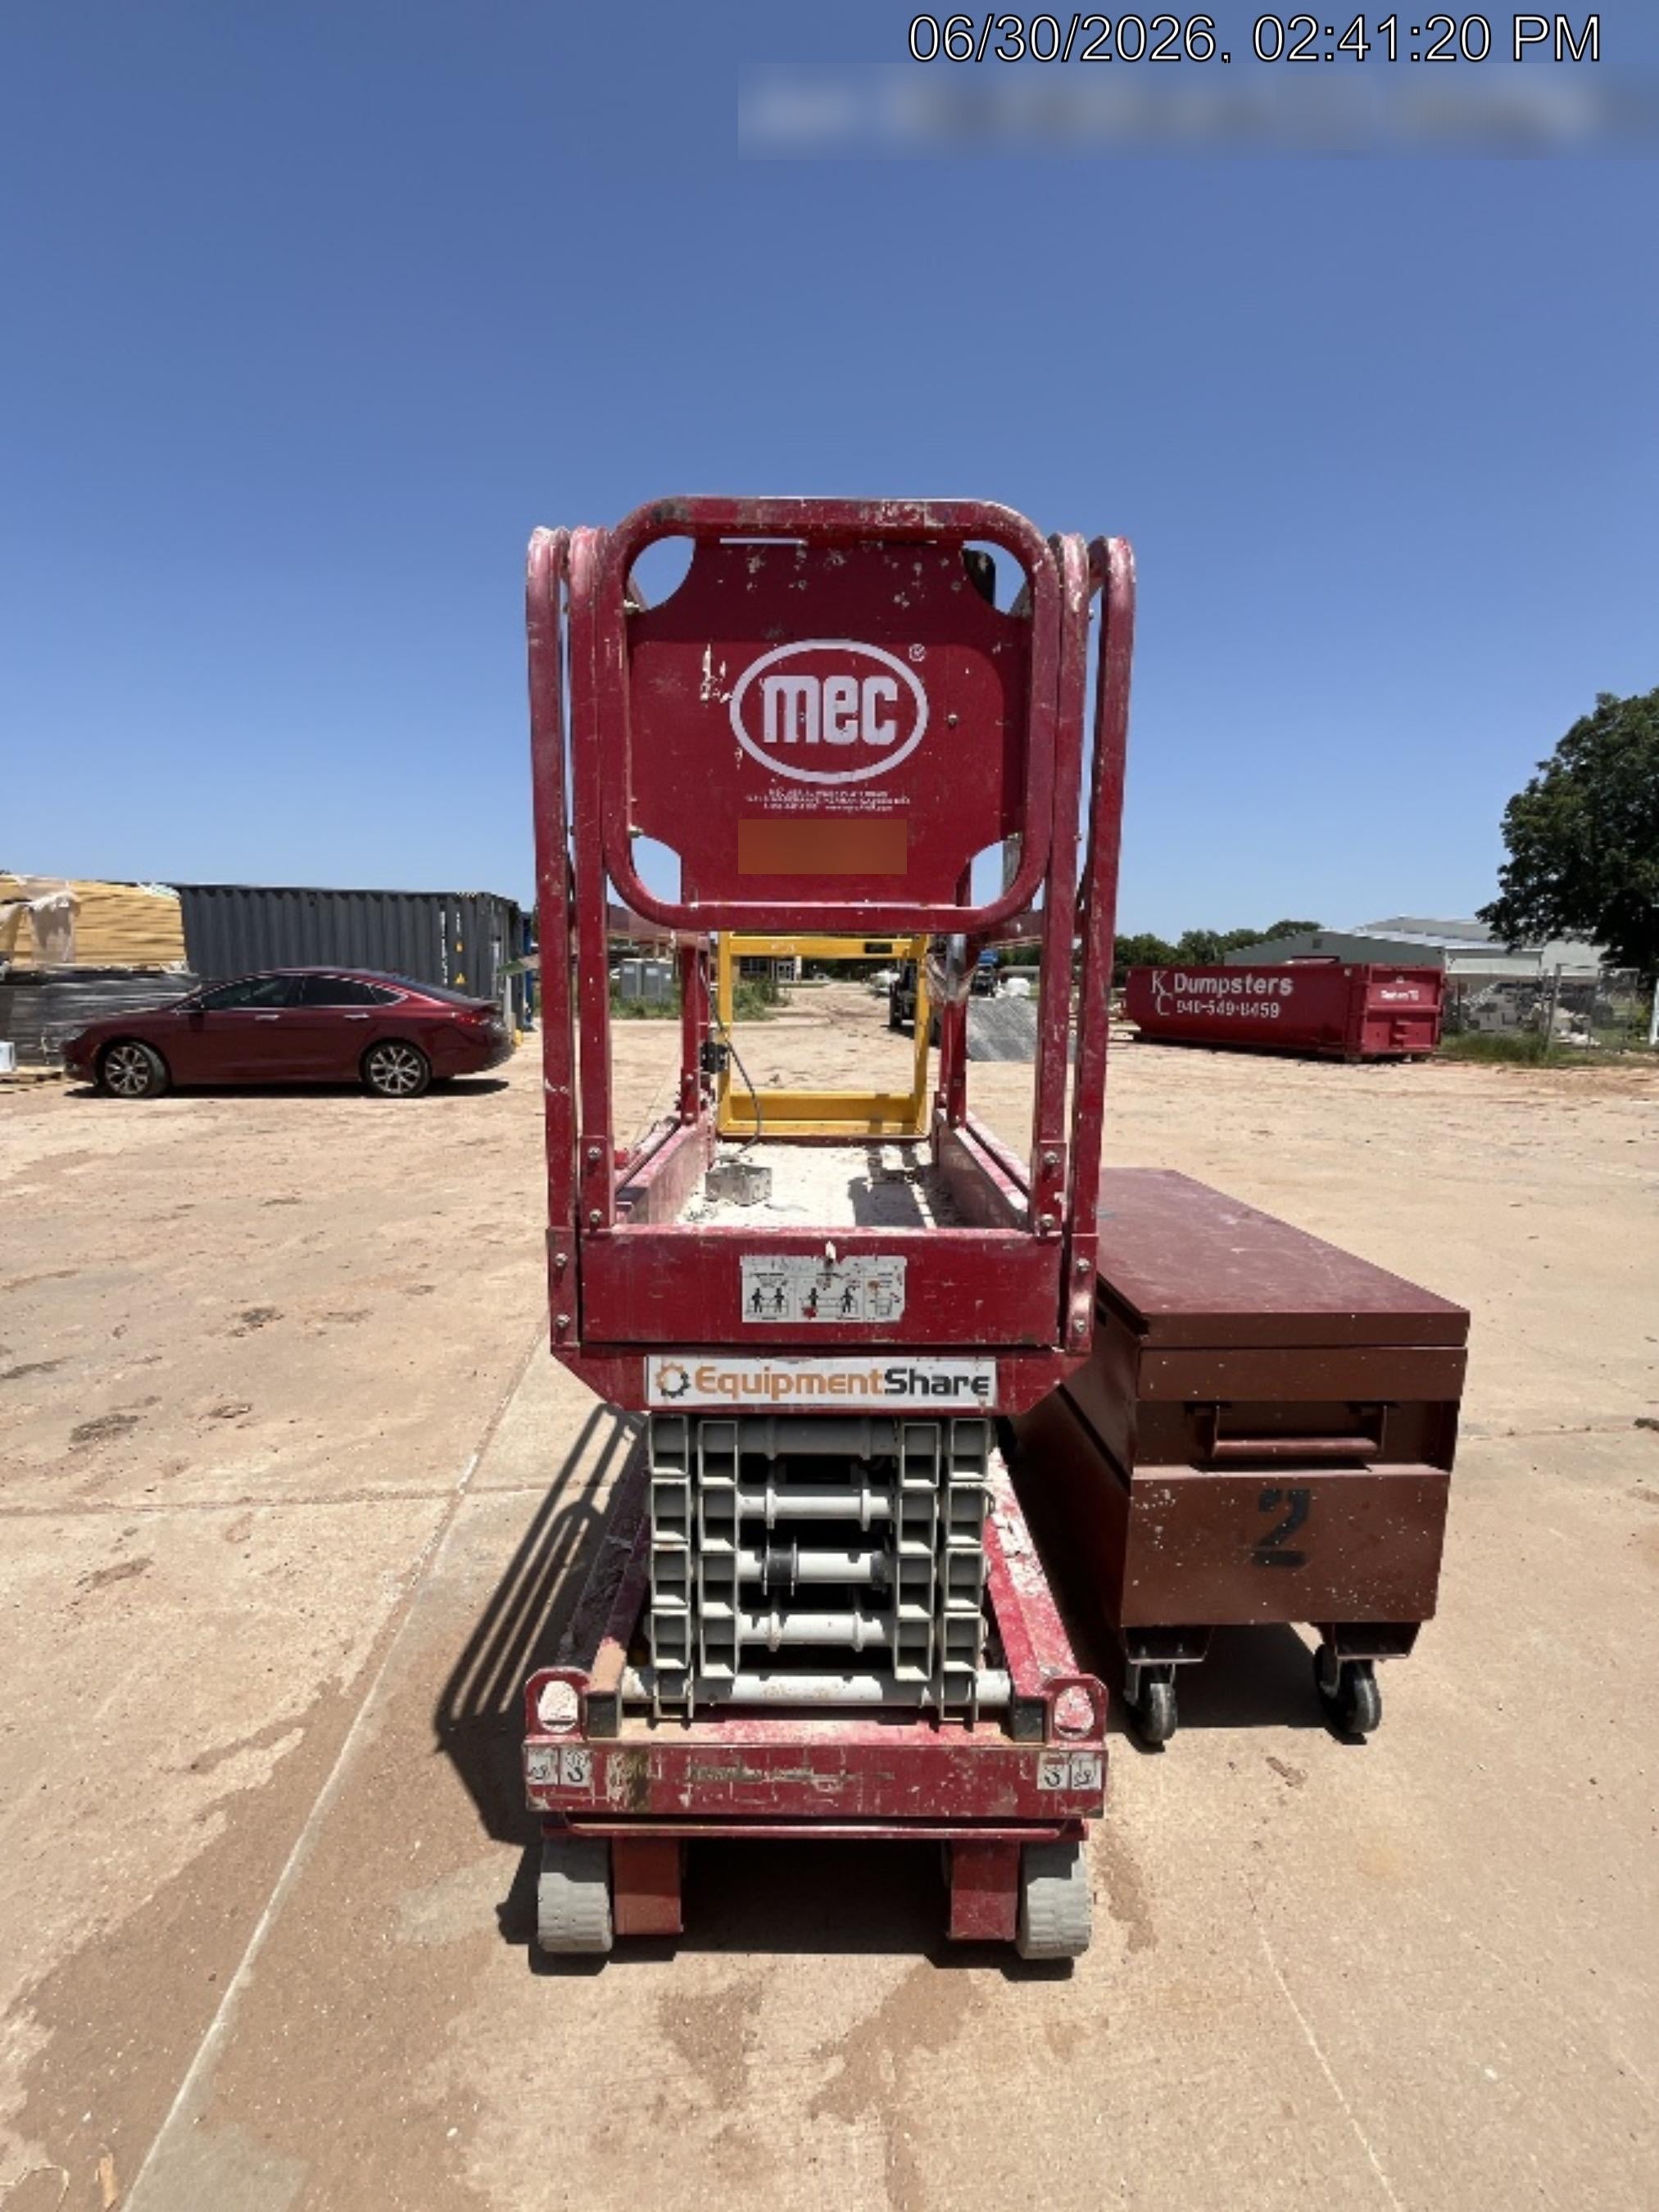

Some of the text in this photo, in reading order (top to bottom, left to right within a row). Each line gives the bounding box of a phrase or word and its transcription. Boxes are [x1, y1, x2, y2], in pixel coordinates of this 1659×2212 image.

[1174, 973, 1294, 998] Dumpsters
[695, 1366, 989, 1400] EquipmentShare
[1252, 1489, 1310, 1566] 2
